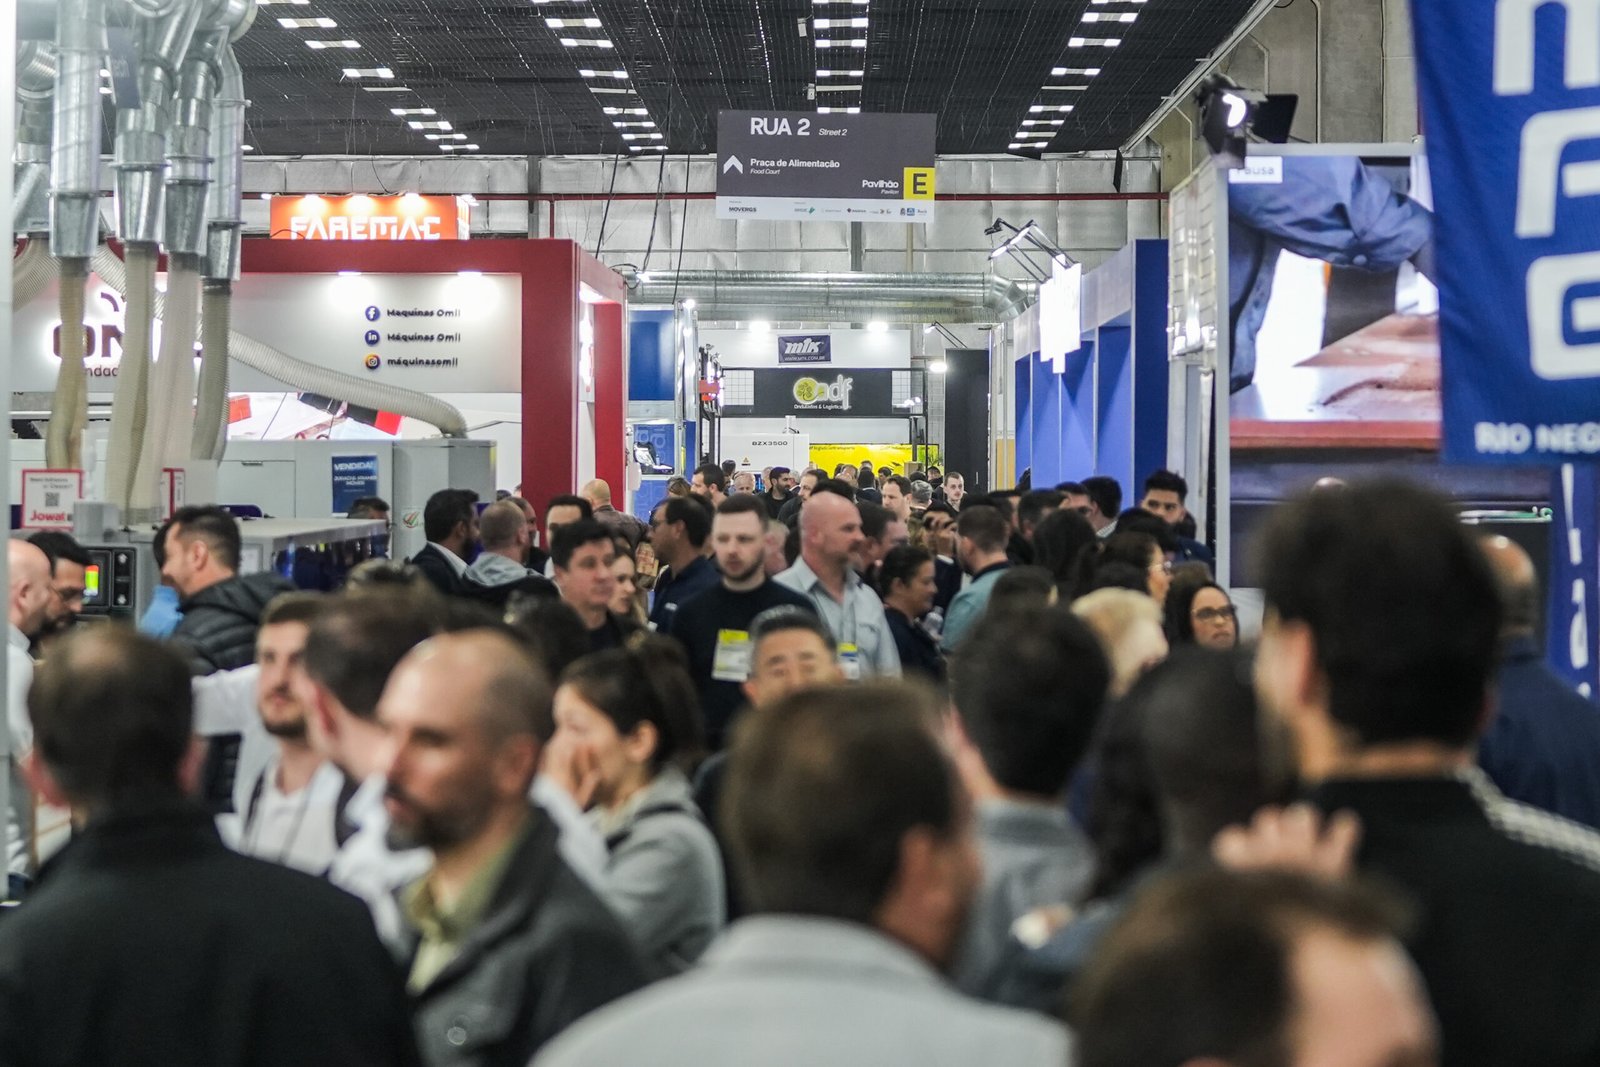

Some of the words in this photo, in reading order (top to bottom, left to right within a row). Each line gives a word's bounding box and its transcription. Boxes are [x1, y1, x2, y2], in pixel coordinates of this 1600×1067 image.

[750, 117, 793, 136] RUA
[797, 117, 811, 136] 2
[818, 128, 841, 136] Street
[841, 128, 848, 136] 2
[750, 158, 776, 168] Praça
[777, 159, 788, 168] de
[789, 159, 841, 169] Alimentação
[765, 168, 781, 176] Court
[1236, 166, 1275, 175] ausa
[862, 179, 900, 189] Pavilhão
[912, 173, 928, 195] E
[290, 216, 441, 240] FAREMAC
[436, 332, 461, 343] Omil
[1473, 421, 1533, 454] RIO
